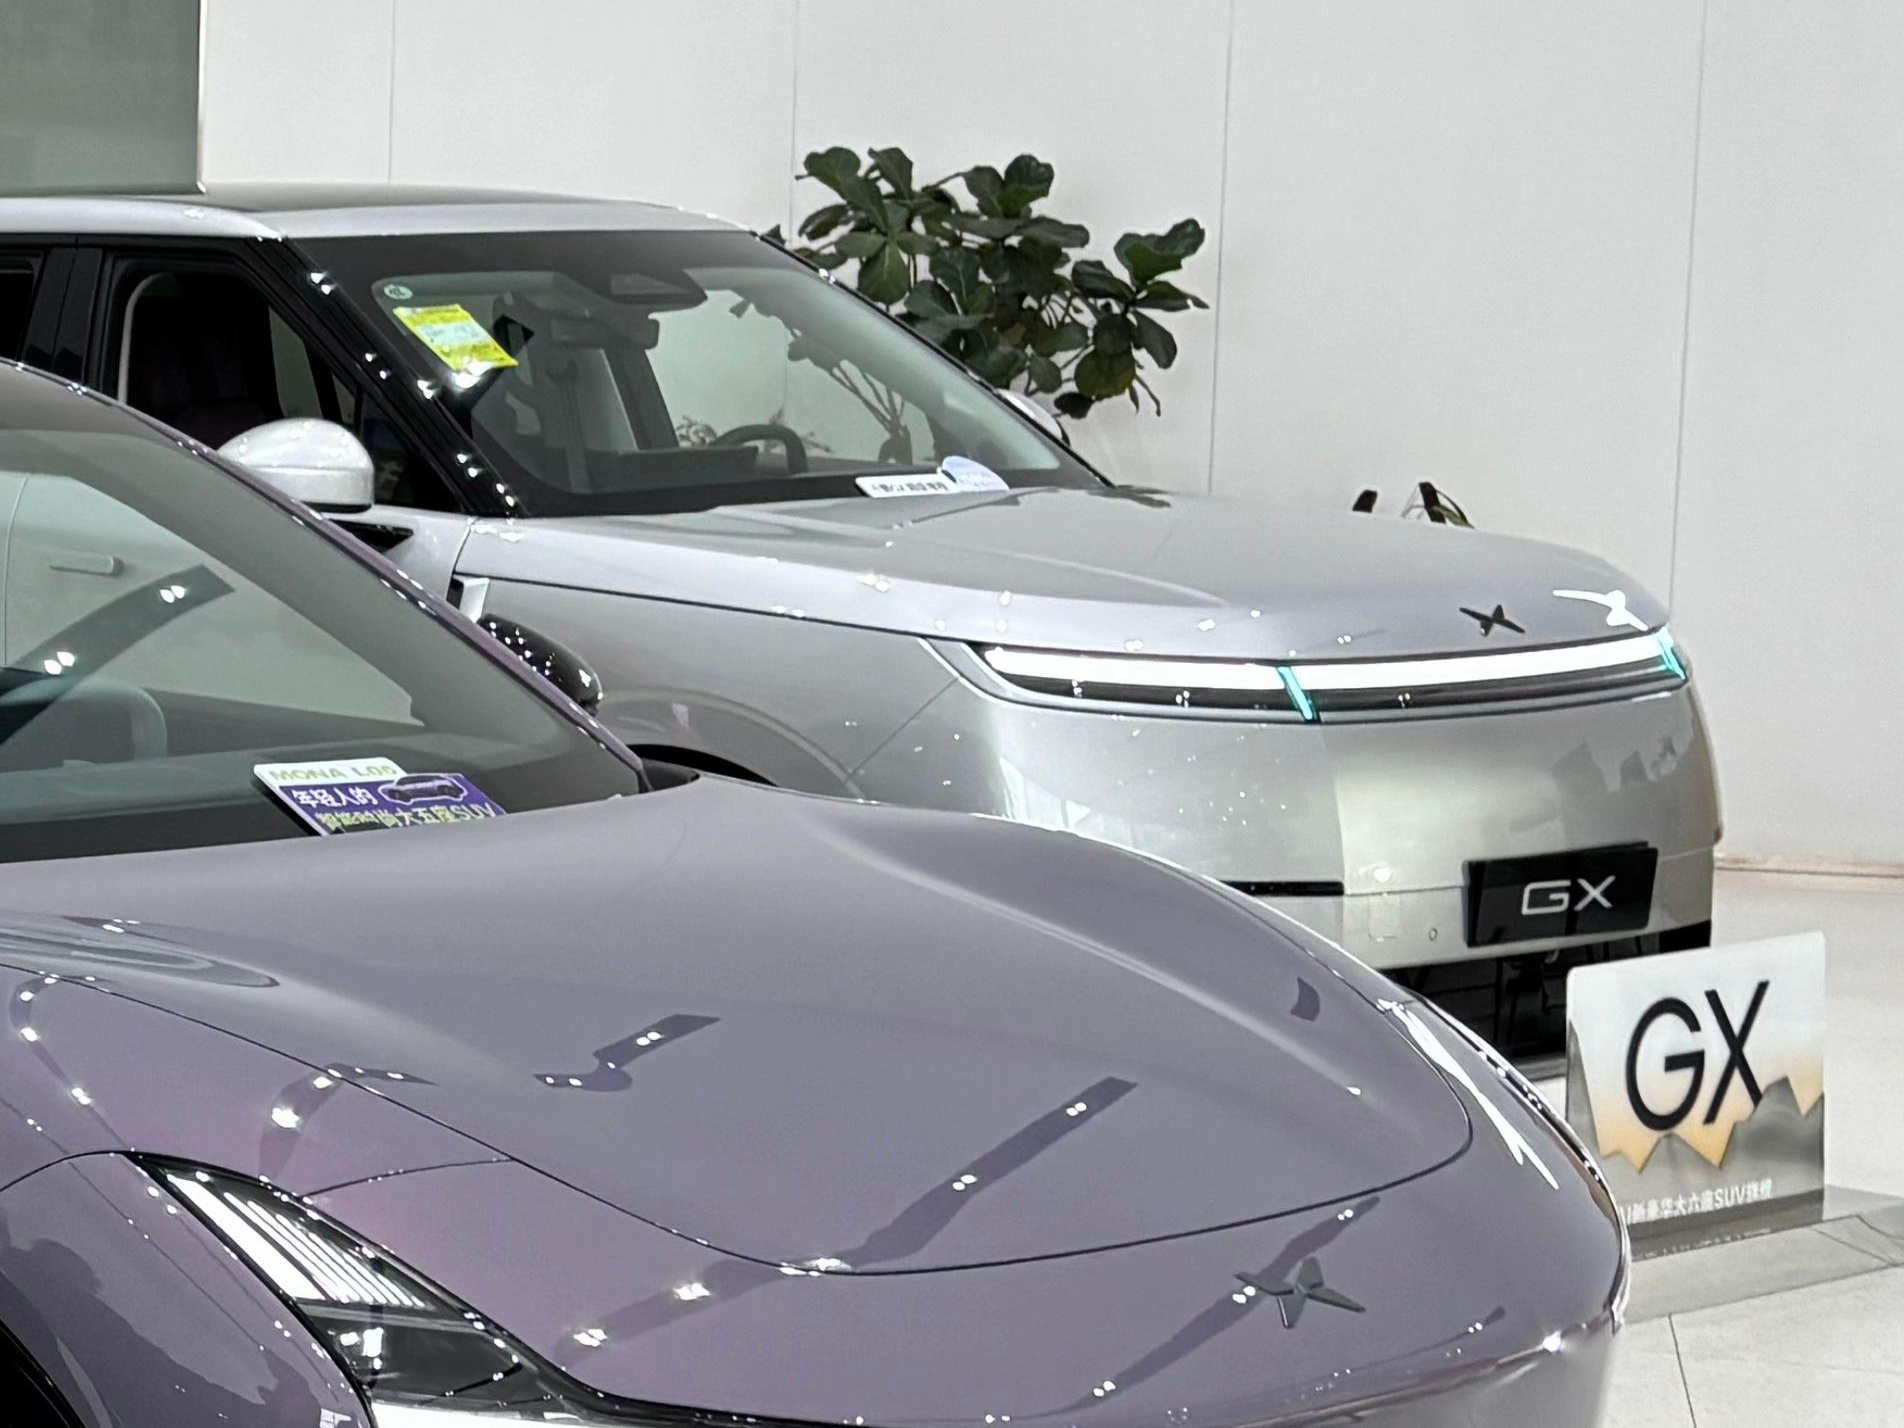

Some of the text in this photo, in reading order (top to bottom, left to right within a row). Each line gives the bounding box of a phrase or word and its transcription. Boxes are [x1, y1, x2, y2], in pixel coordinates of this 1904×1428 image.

[268, 766, 345, 781] MONA
[291, 786, 379, 808] 年轻人的
[1520, 874, 1616, 917] GX
[1625, 980, 1770, 1132] GX
